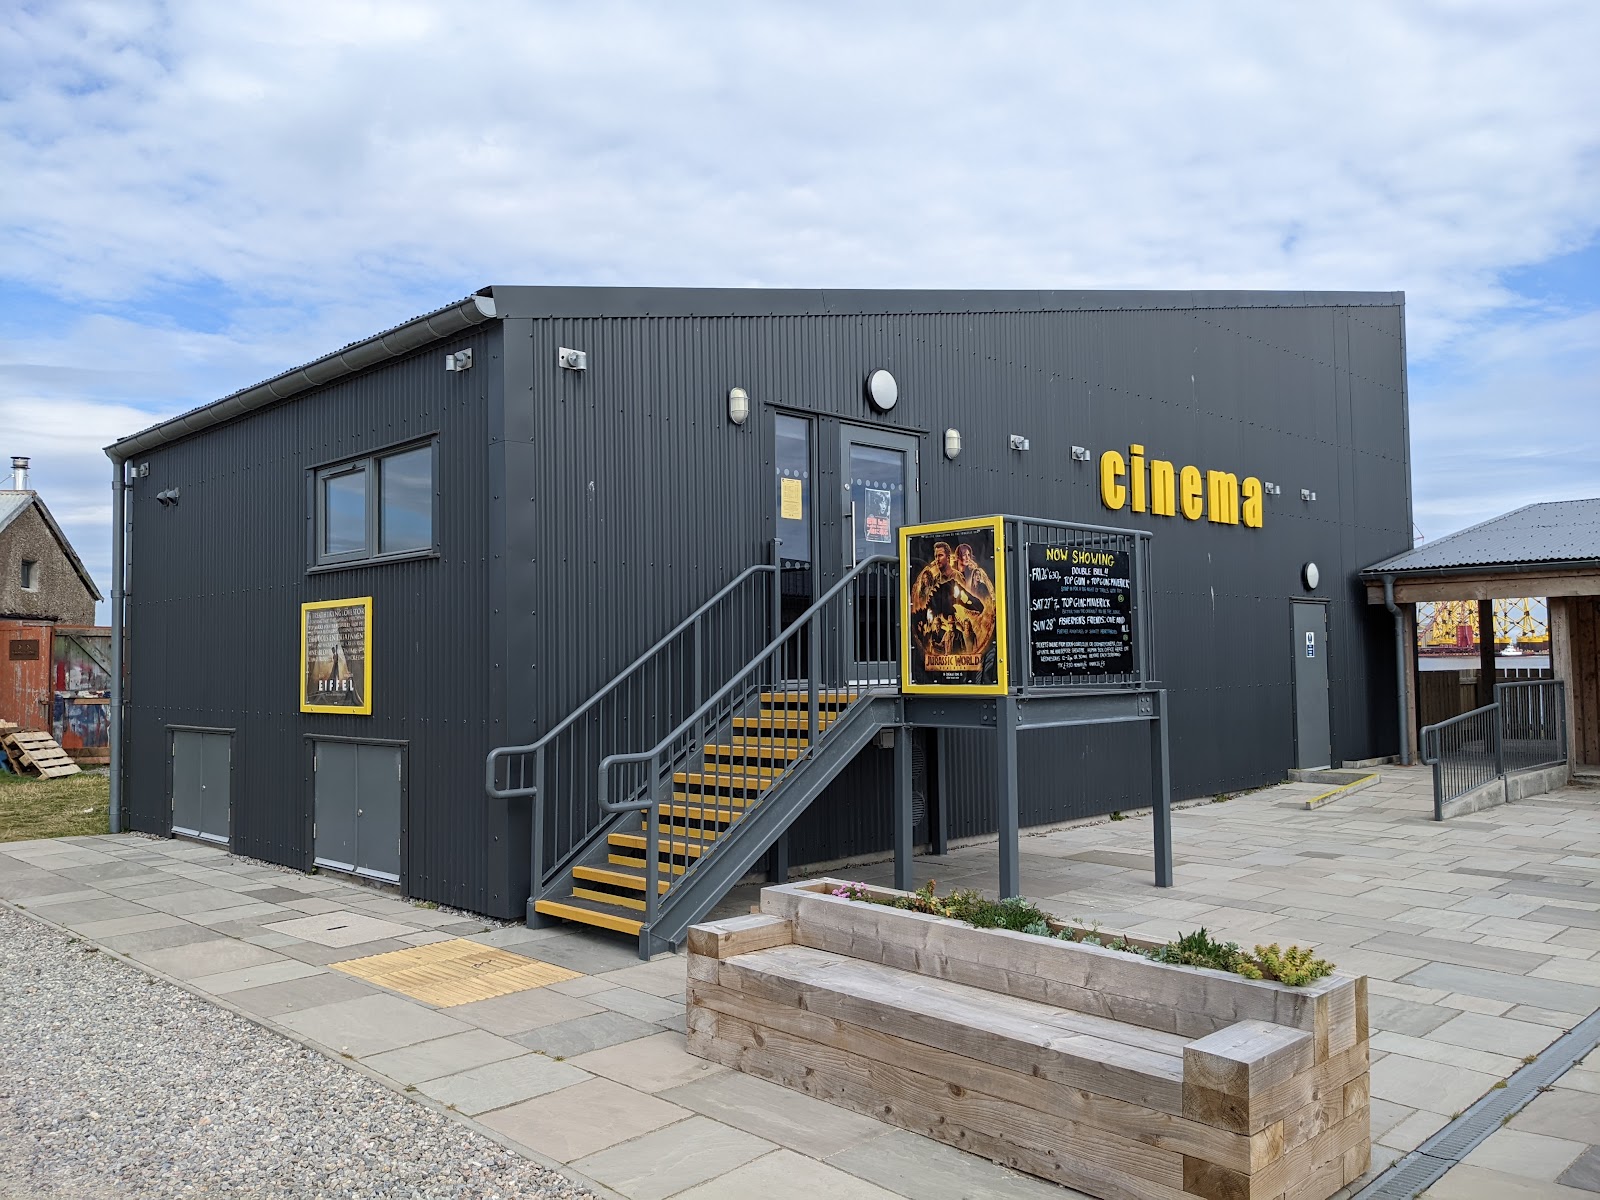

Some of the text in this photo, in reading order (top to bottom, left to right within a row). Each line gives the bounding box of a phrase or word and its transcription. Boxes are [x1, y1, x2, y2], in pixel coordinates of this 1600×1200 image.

[1101, 444, 1263, 528] cinema
[1046, 548, 1115, 567] NOW SHOWING
[1071, 567, 1092, 575] DOUBLE
[1064, 576, 1073, 585] TOP
[1074, 577, 1086, 586] GUN
[1091, 577, 1099, 586] TOP
[1032, 598, 1043, 611] SAT
[1061, 597, 1073, 608] TOP
[1116, 616, 1125, 624] AND
[1033, 620, 1046, 632] SUN
[926, 655, 980, 666] JURASSIC WORLD
[319, 679, 354, 691] EIFFEL
